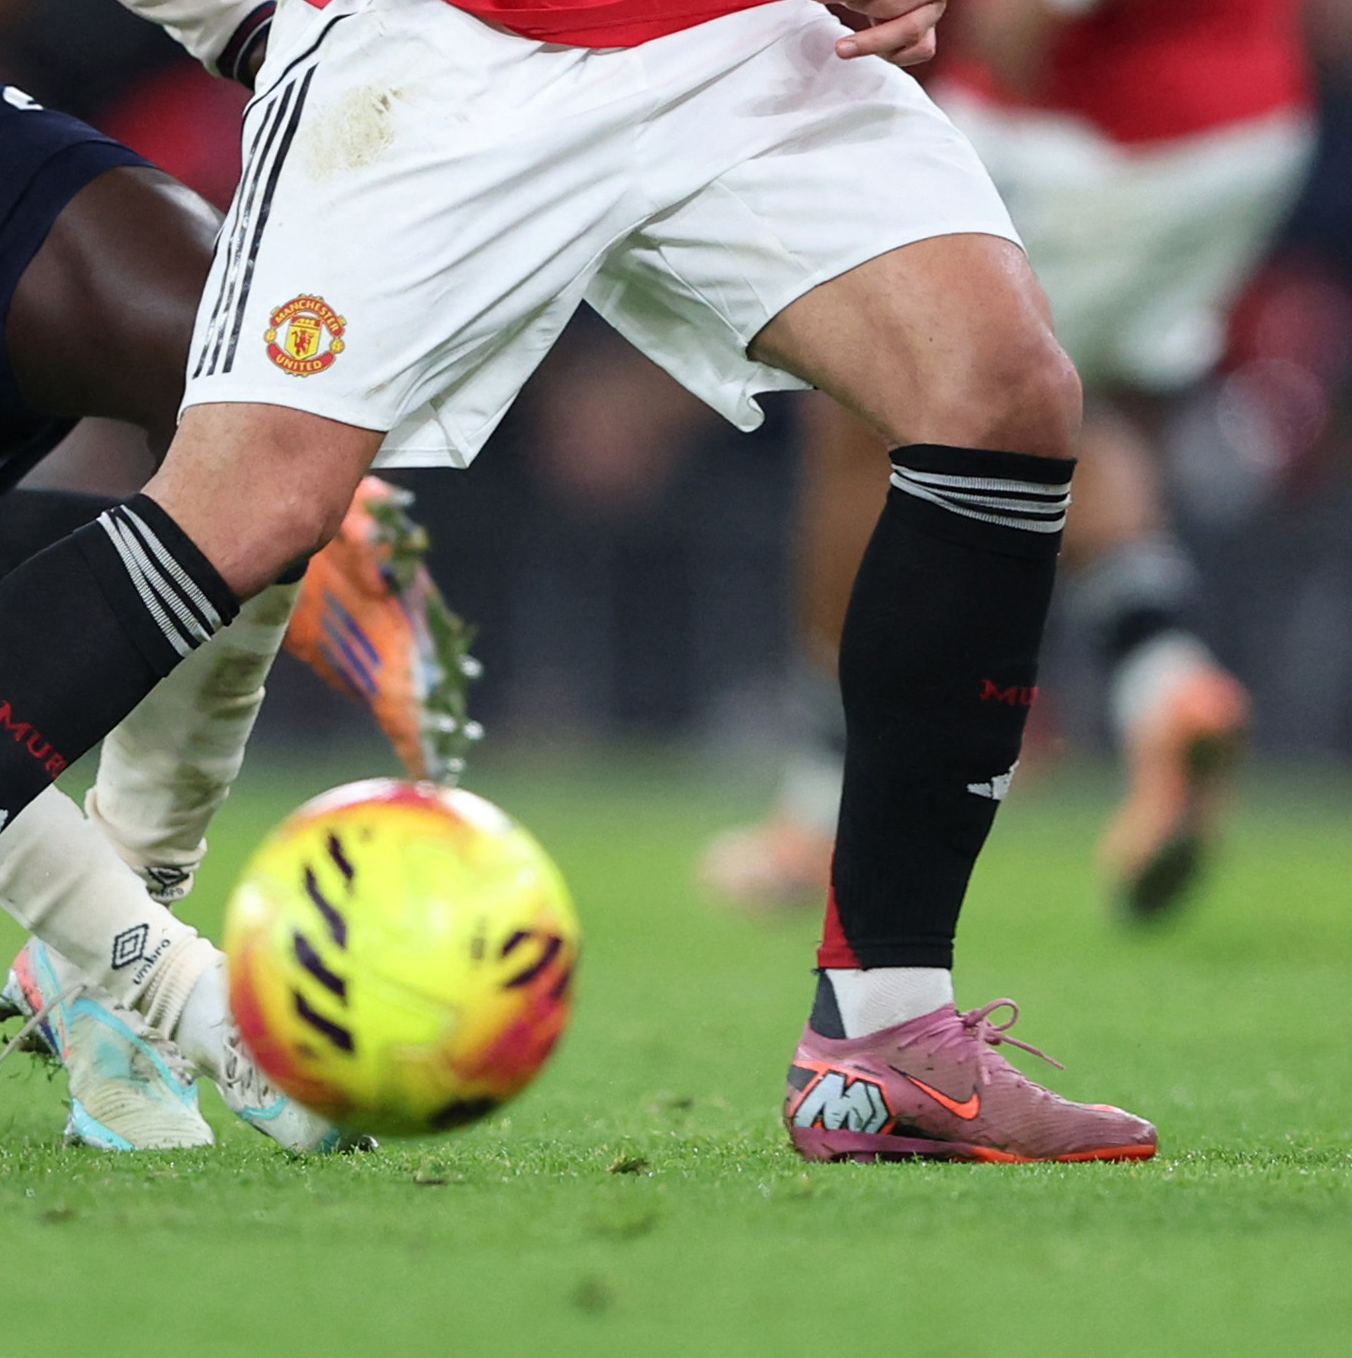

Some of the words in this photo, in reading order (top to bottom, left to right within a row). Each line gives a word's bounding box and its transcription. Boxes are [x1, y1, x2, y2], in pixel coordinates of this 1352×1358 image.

[275, 299, 340, 332] MANCHESTER
[275, 354, 322, 372] UNITED
[132, 938, 172, 986] umbro
